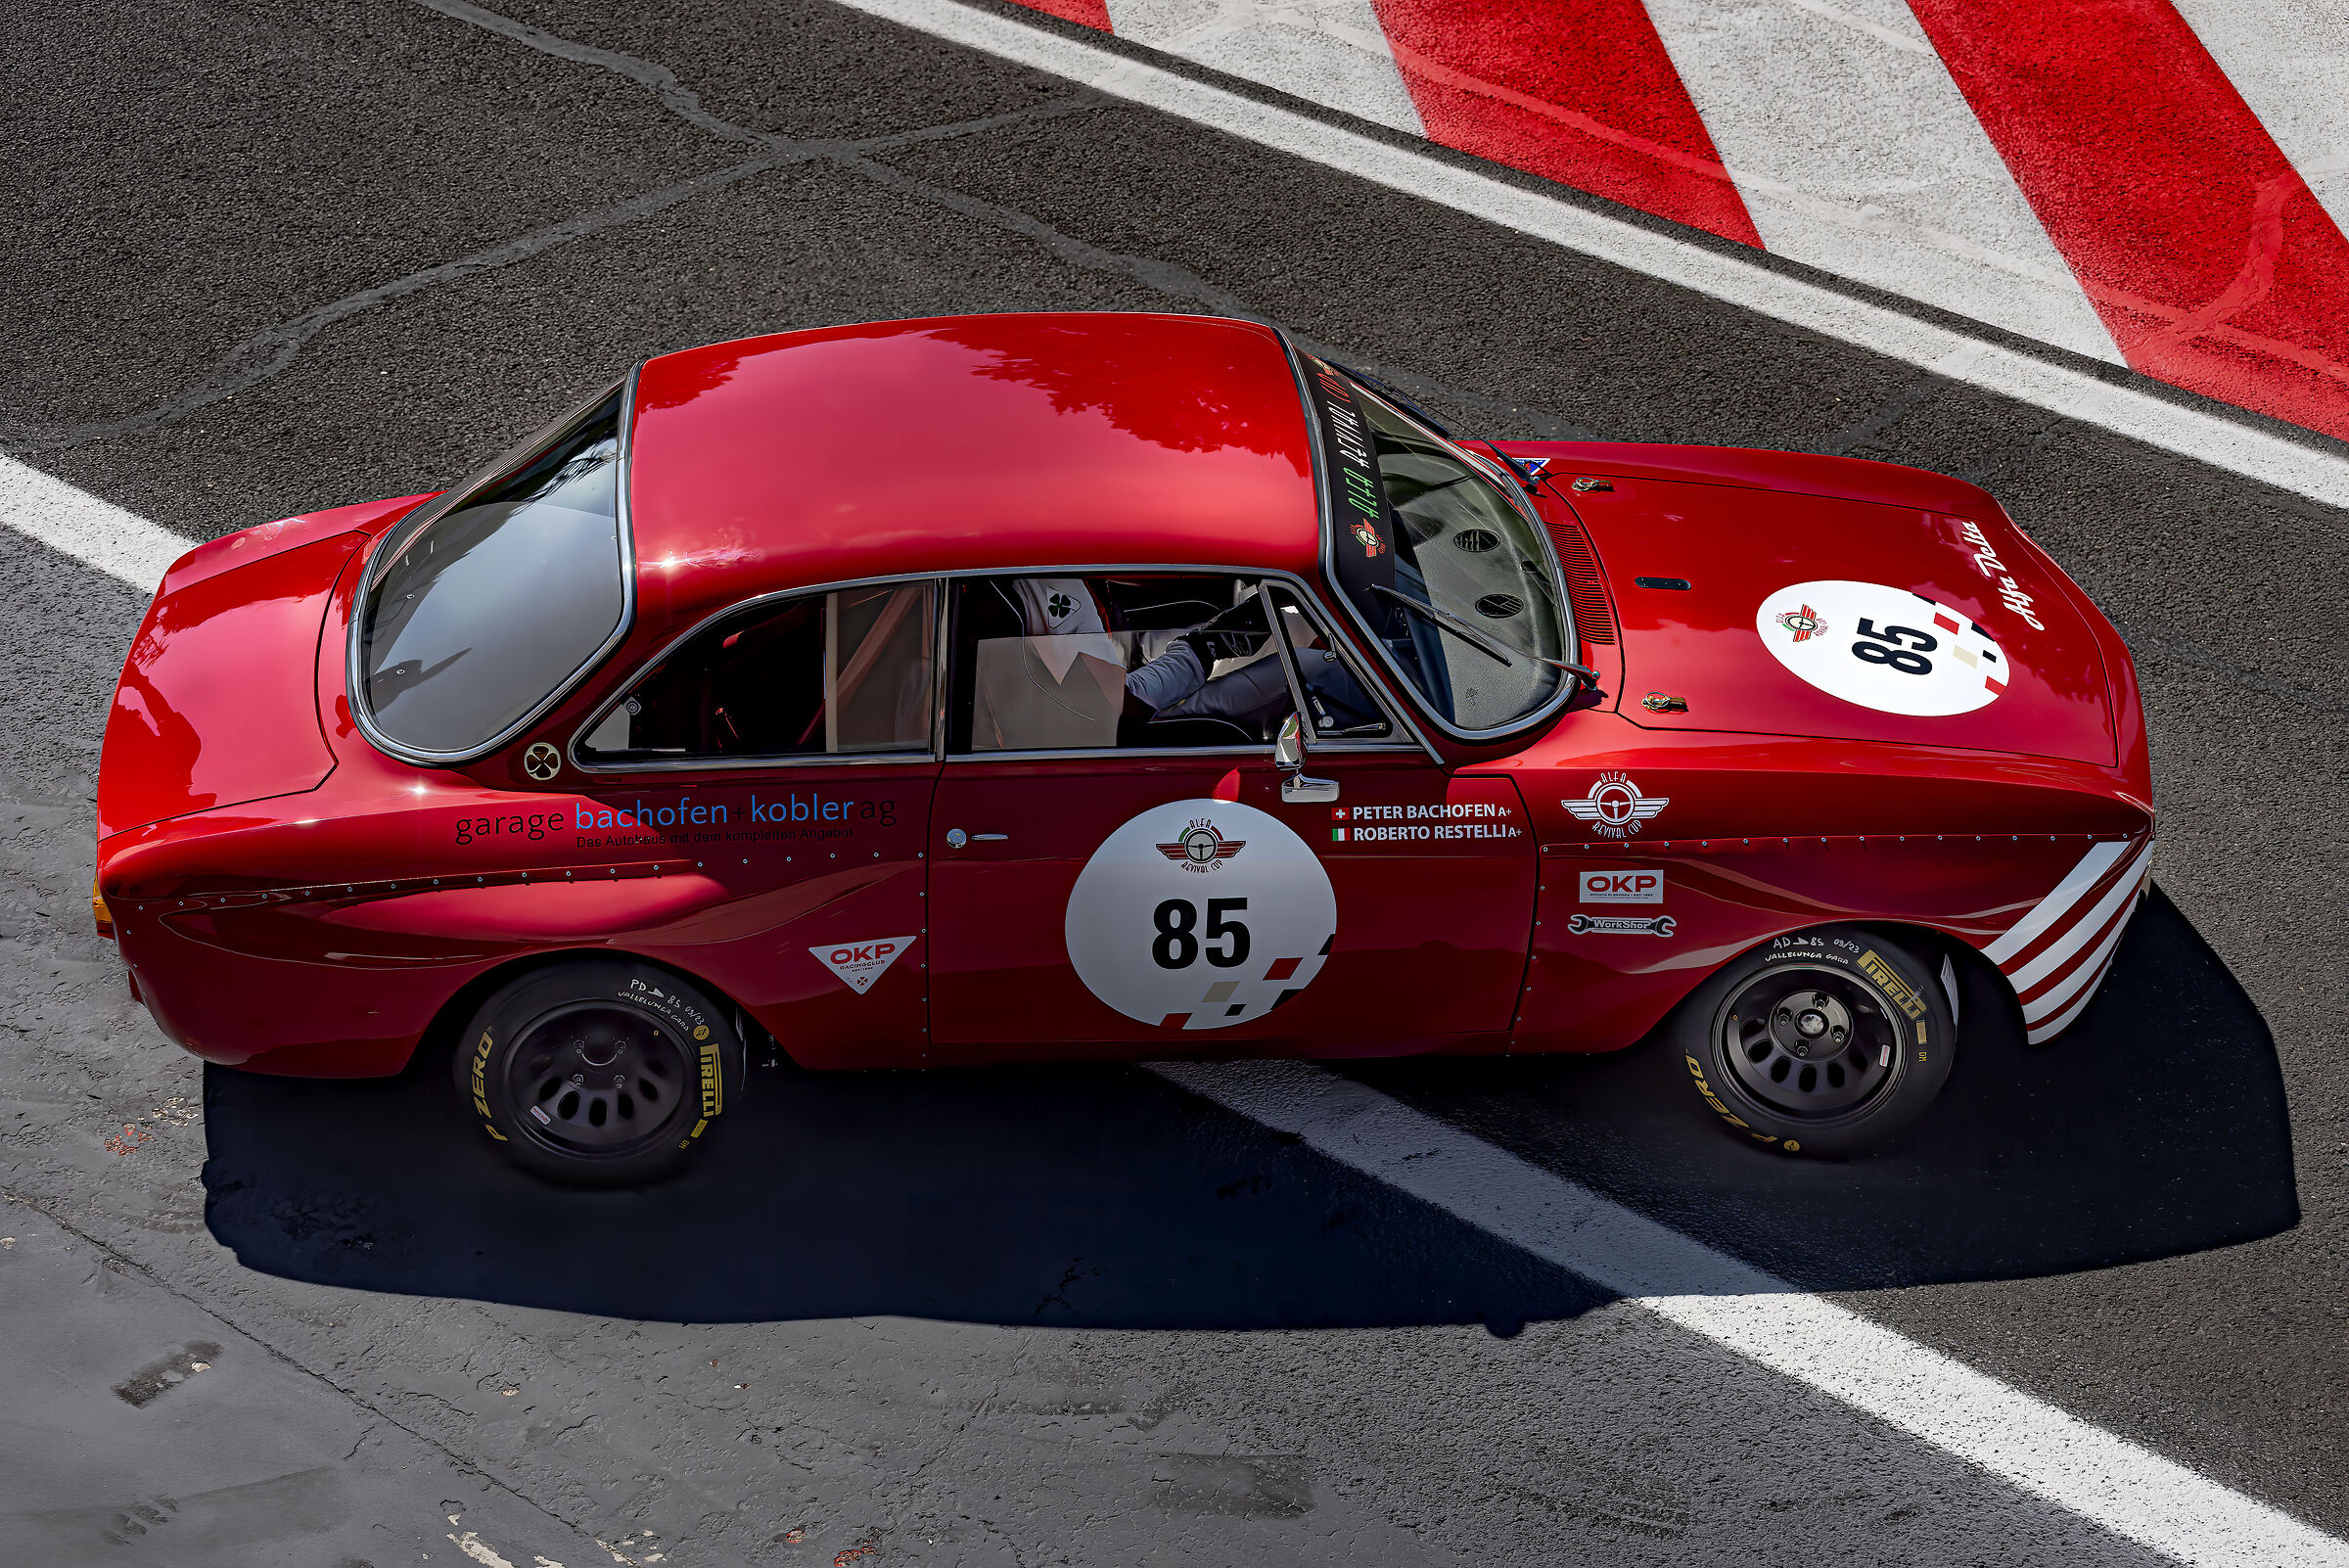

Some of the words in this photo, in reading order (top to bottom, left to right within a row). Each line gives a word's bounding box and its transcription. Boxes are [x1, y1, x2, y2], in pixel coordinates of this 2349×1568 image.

[1326, 400, 1370, 469] REVIVAL
[1343, 467, 1380, 520] ALFA
[1961, 521, 2007, 577] Delta
[1998, 576, 2046, 631] Alfa
[1852, 618, 1938, 675] 85
[1600, 771, 1627, 783] ALFA
[455, 808, 565, 846] garage
[859, 799, 898, 828] ag
[1190, 817, 1212, 829] ALFA
[1353, 806, 1404, 820] PETER
[1406, 804, 1497, 819] BACHOFEN
[1498, 807, 1512, 818] A+
[576, 836, 602, 849] Das
[605, 833, 667, 848] Autohaus
[669, 832, 690, 845] mit
[800, 827, 853, 843] Angebot
[1354, 826, 1431, 842] ROBERTO
[1434, 824, 1506, 840] RESTELLI
[1508, 827, 1523, 838] A+
[1591, 820, 1627, 839] REVIVAL
[1628, 819, 1643, 835] CUP
[1180, 860, 1210, 874] REVIVAL
[1210, 859, 1223, 870] CUP
[1587, 875, 1657, 893] OKP
[1151, 897, 1251, 970] 85
[1773, 937, 1791, 948] AD
[830, 943, 896, 965] OKP
[630, 979, 646, 992] PD
[667, 994, 681, 1008] 85
[1856, 949, 1927, 1020] PIRELLI
[472, 1031, 494, 1119] ZERO
[700, 1042, 722, 1117] PIRELLI
[1685, 1054, 1750, 1128] ZERO
[484, 1124, 508, 1141] P
